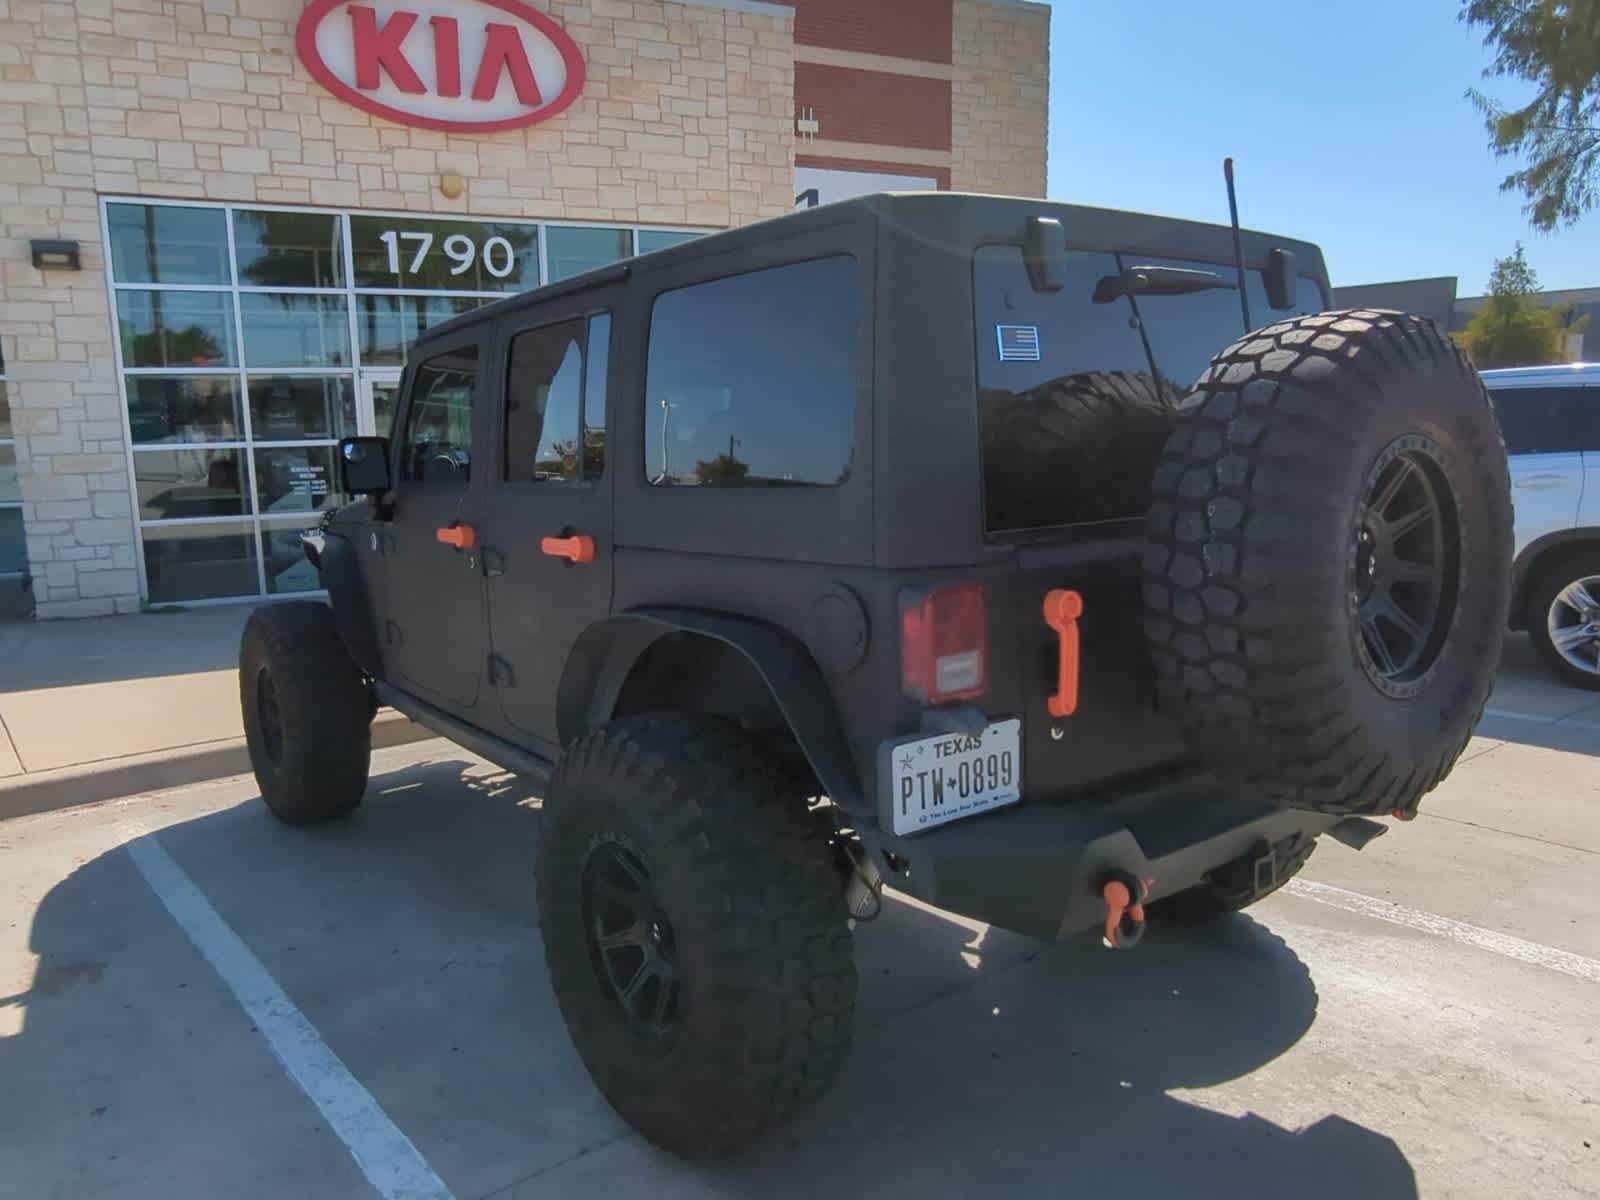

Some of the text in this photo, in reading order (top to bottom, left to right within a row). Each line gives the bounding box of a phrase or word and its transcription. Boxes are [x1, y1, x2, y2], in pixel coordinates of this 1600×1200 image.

[347, 5, 543, 106] KIA
[379, 230, 514, 278] 1790
[933, 736, 982, 759] TEXAS
[902, 767, 944, 815] PTW
